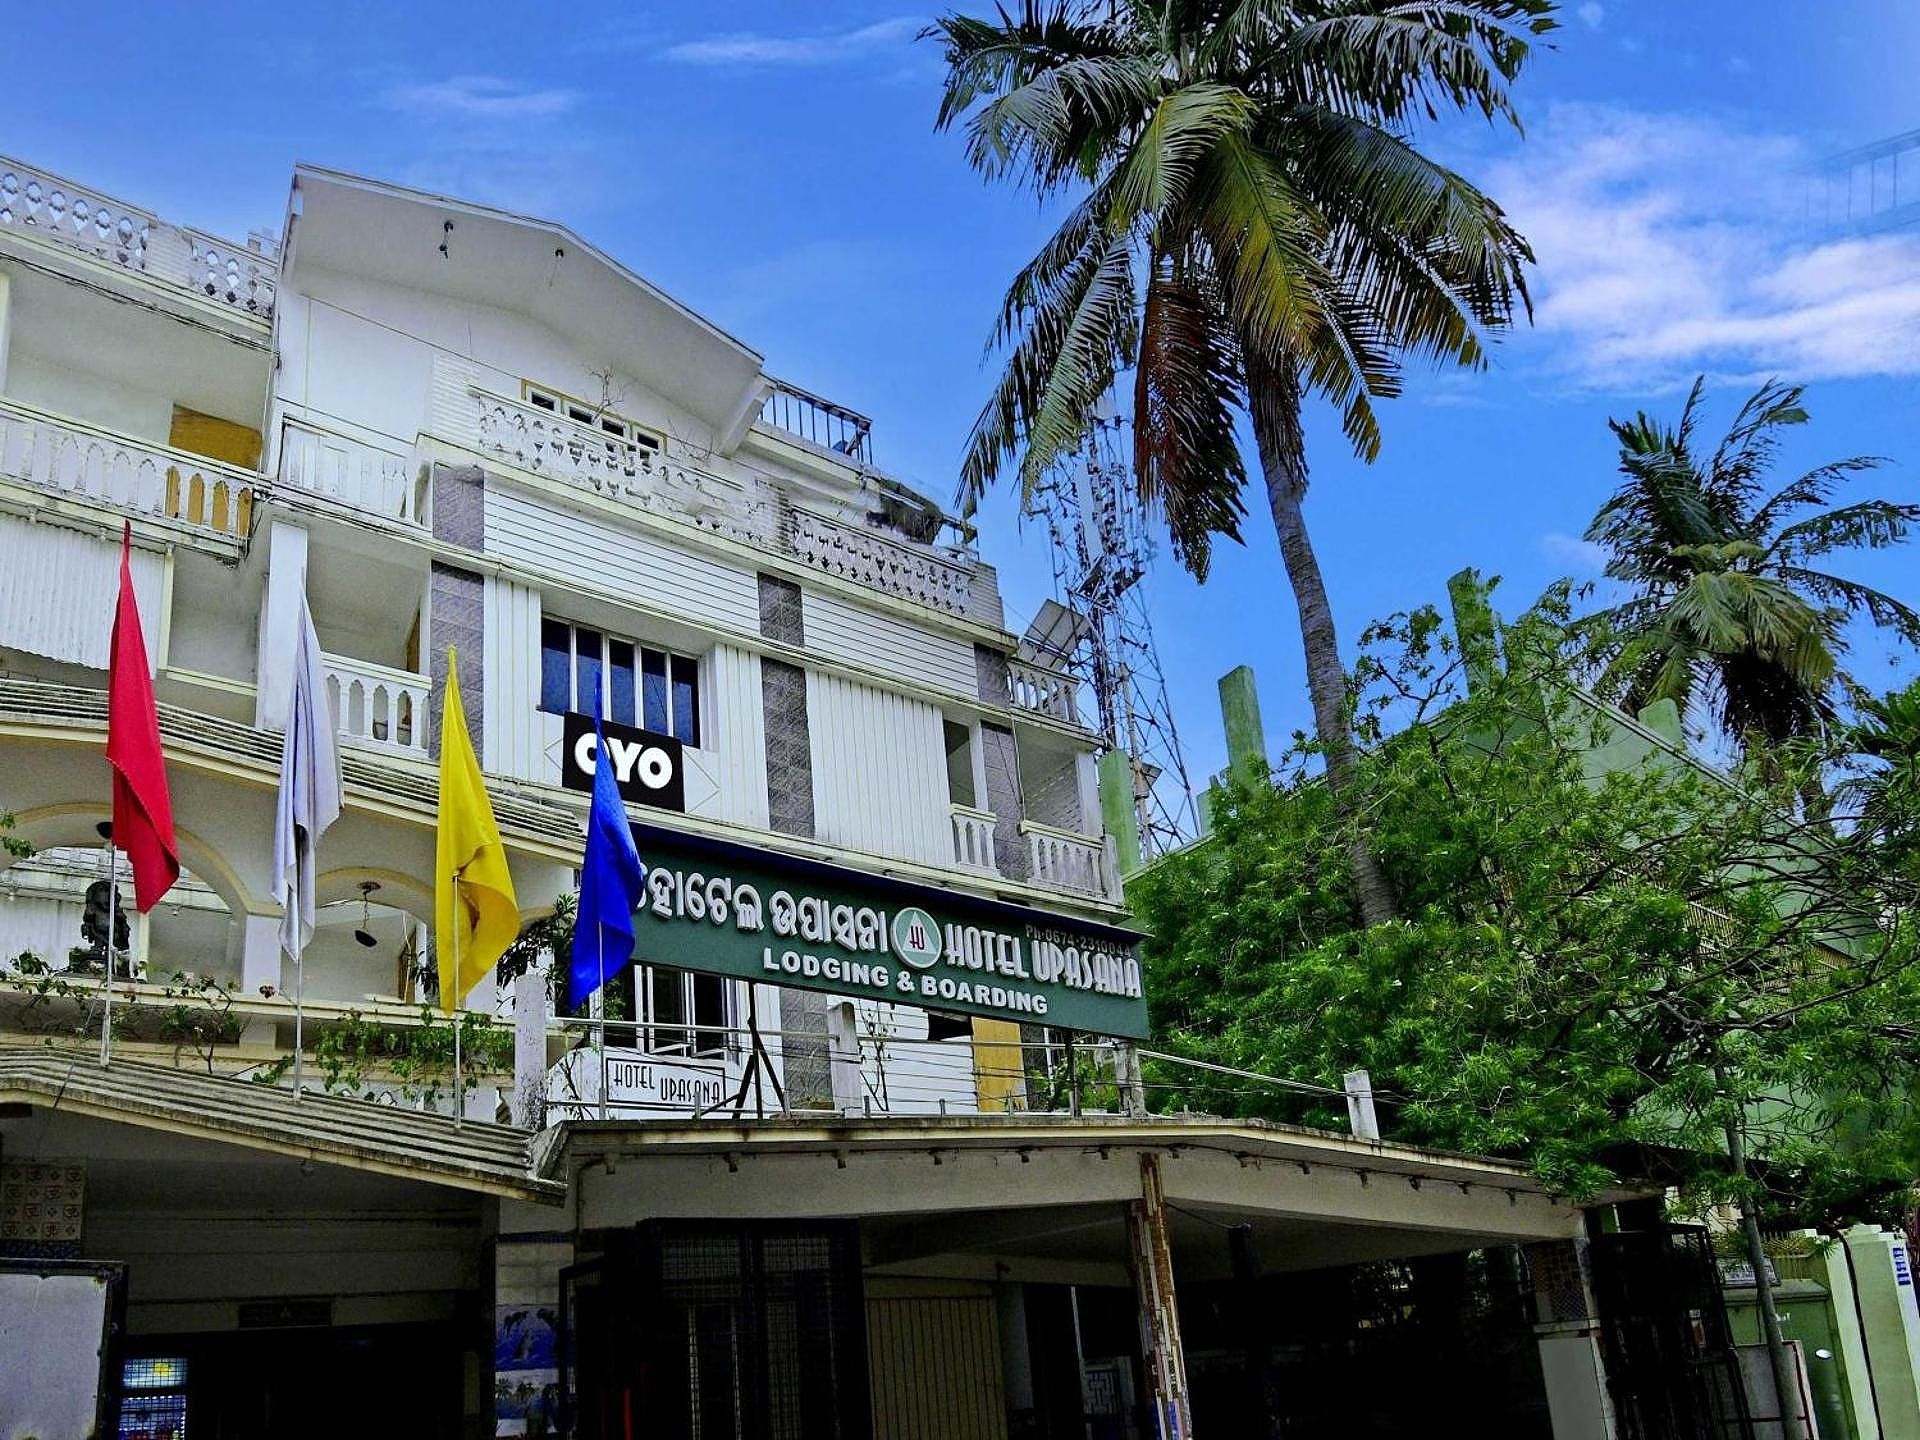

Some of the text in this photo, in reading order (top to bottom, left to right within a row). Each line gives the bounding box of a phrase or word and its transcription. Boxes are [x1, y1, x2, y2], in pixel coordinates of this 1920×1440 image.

[574, 732, 673, 789] OYO
[763, 947, 1049, 1014] LODGING & BOARDING
[943, 923, 1142, 998] HOTEL UPASANA
[613, 1063, 721, 1104] HOTEL UPASANA
